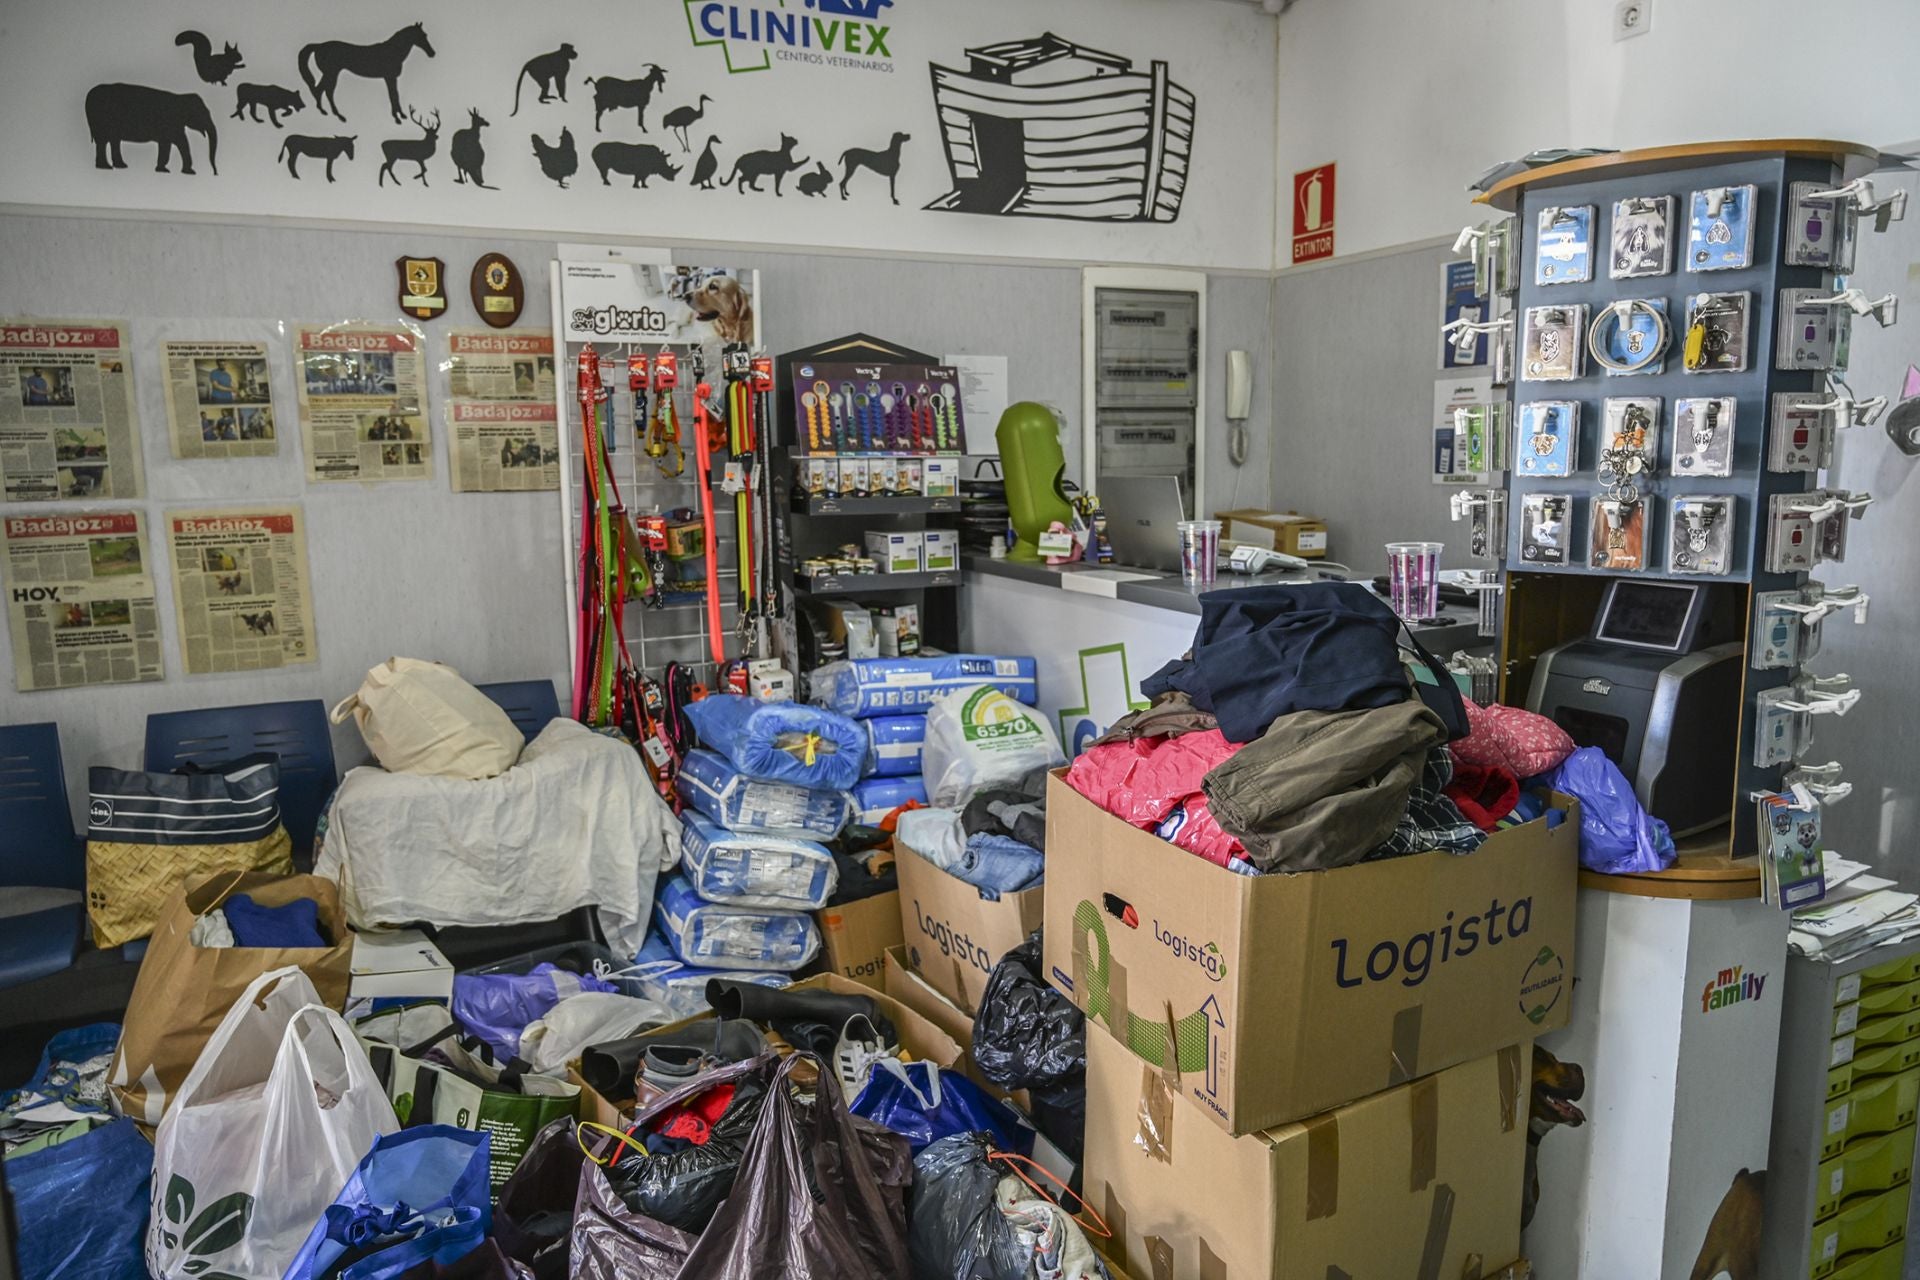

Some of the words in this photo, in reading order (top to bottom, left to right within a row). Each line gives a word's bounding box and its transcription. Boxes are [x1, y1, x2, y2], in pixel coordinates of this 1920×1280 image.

[700, 3, 892, 58] CLINIVEX
[776, 50, 824, 65] CENTROS
[826, 55, 894, 74] VETERINARIOS
[1294, 236, 1332, 258] EXTINTOR
[309, 333, 388, 351] Badajoz
[457, 337, 529, 353] Badajoz
[460, 405, 532, 421] Badajoz
[10, 518, 101, 536] Badajoz
[181, 519, 264, 533] Badajoz
[90, 807, 109, 816] LIDL
[845, 954, 887, 978] logis
[1717, 965, 1742, 987] my
[1520, 973, 1563, 996] REUTILIZABLE
[1702, 973, 1766, 1013] family
[1194, 1087, 1208, 1102] MUY
[1207, 1098, 1229, 1120] FRÁGIL
